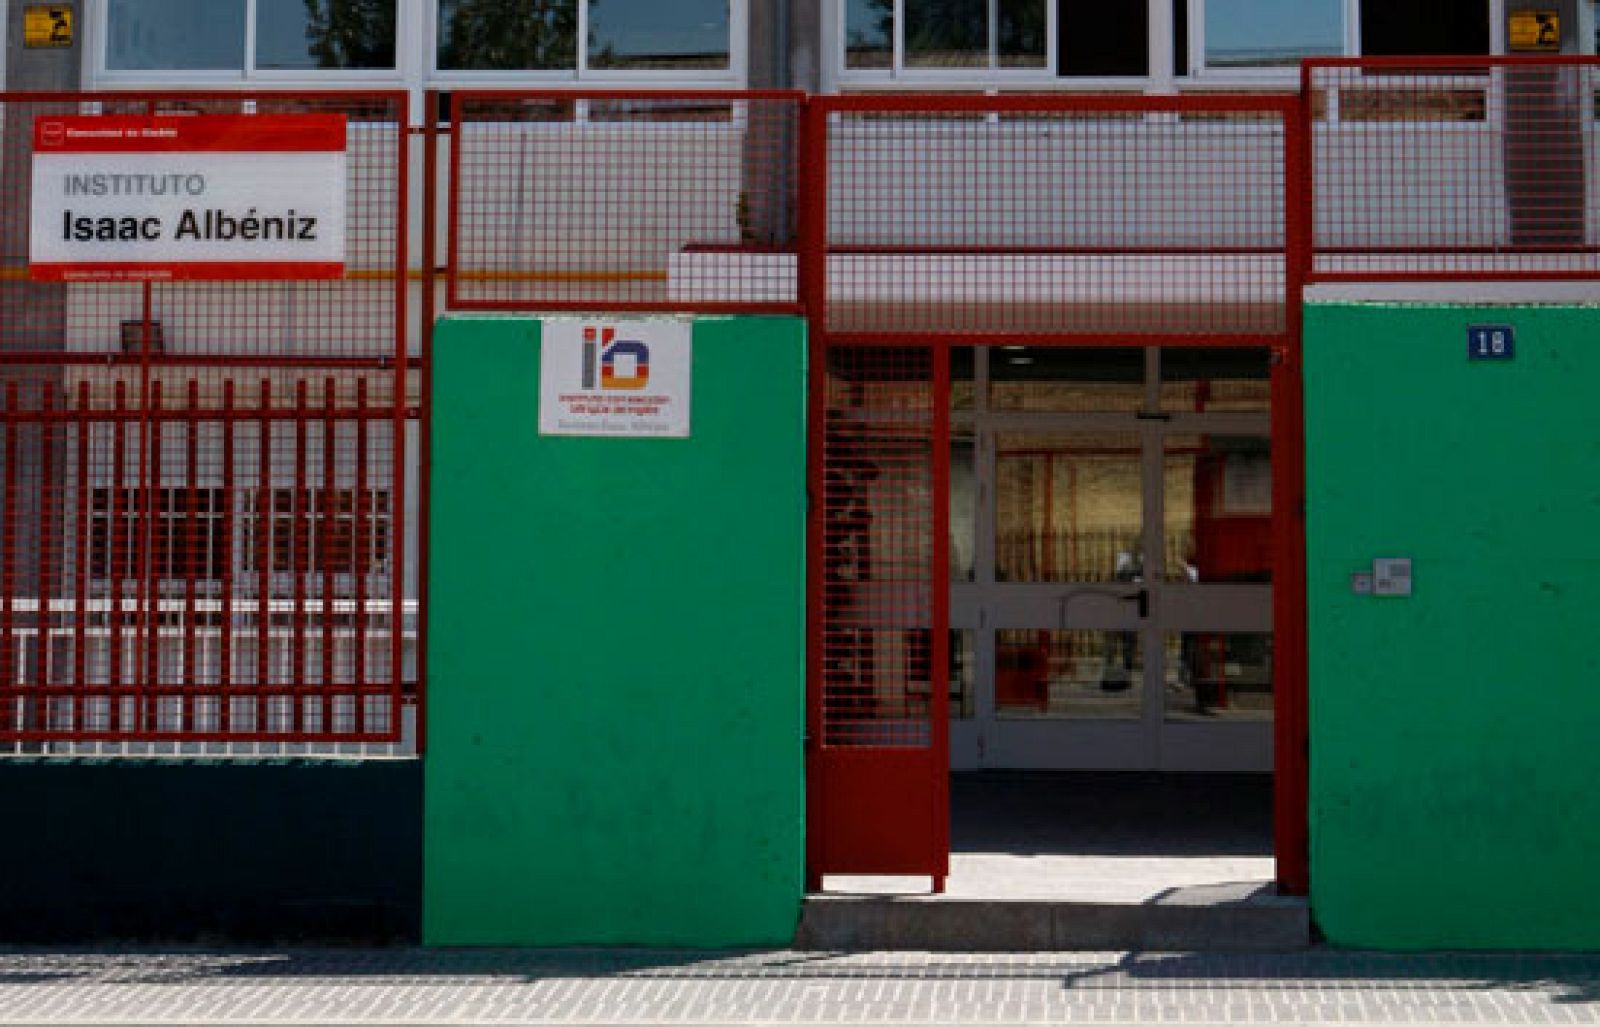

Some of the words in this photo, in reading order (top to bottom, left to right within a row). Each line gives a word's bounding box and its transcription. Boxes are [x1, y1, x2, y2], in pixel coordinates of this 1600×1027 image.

[63, 174, 205, 196] INSTITUTO
[63, 208, 161, 241] Isaac
[174, 207, 318, 241] Albéniz
[1477, 331, 1505, 354] 18
